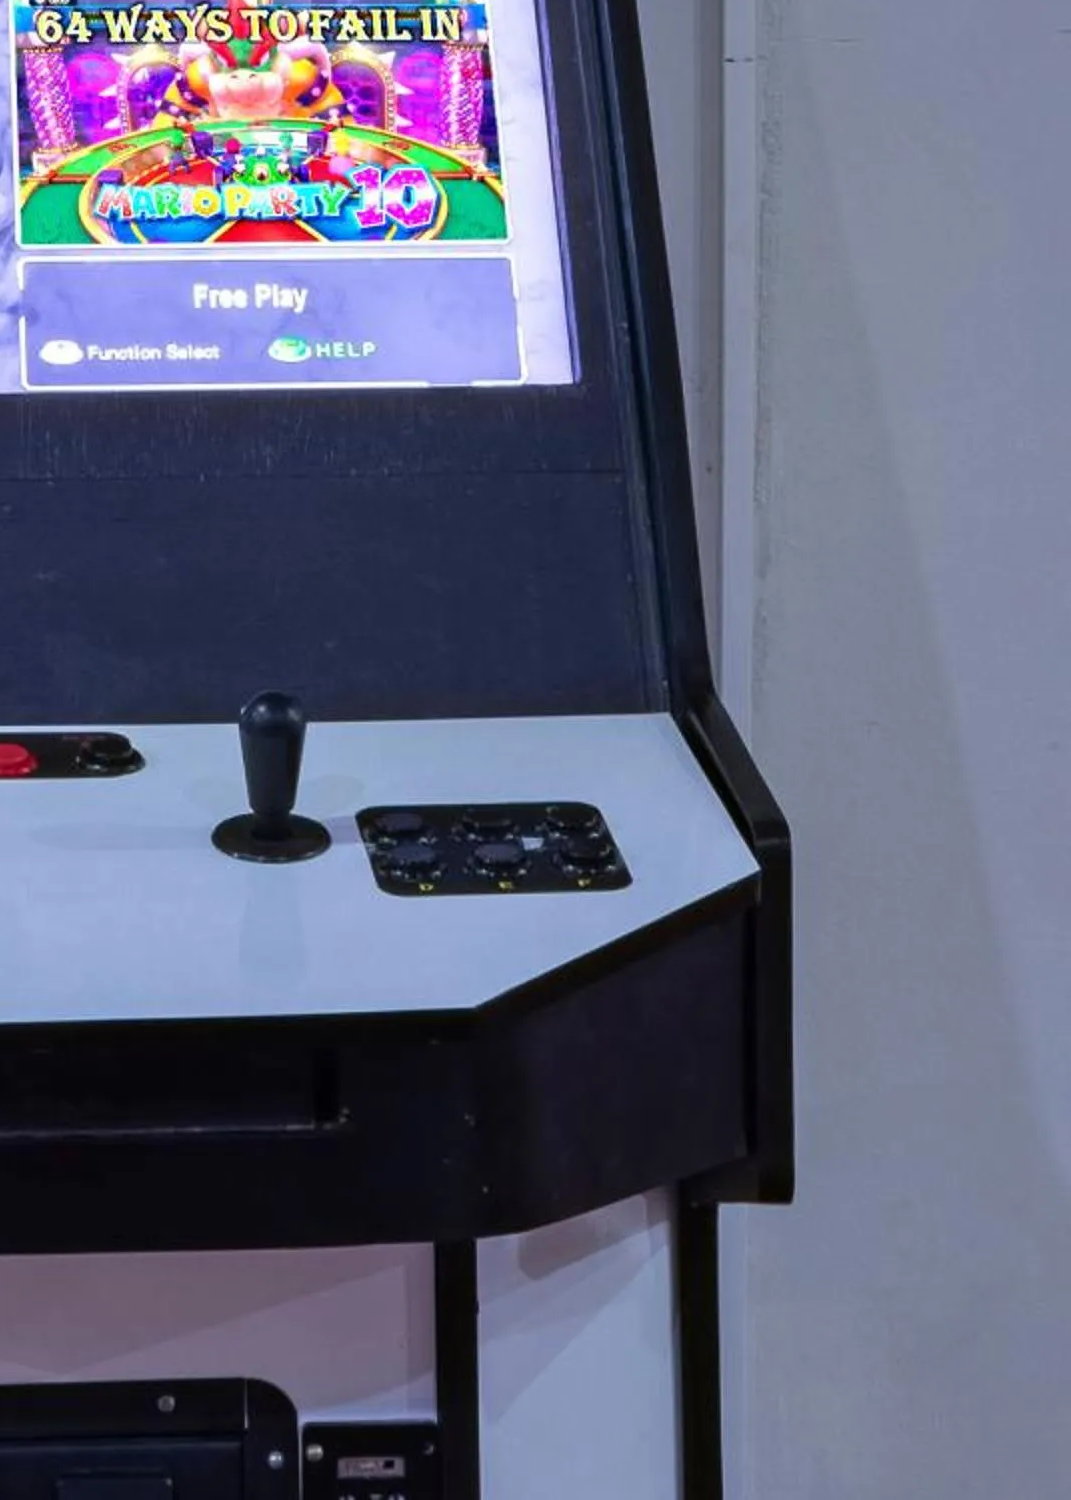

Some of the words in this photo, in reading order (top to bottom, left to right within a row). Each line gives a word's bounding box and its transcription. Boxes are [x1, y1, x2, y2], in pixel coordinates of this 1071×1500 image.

[36, 9, 93, 45] 64
[98, 3, 232, 45] WAYS
[245, 7, 306, 43] TO
[310, 7, 414, 42] FAIL
[418, 7, 461, 41] IN
[95, 184, 216, 219] MARIO
[221, 184, 349, 219] PARTY
[351, 164, 439, 229] 10
[193, 285, 248, 308] Free
[254, 284, 309, 313] Play
[87, 344, 163, 361] Function
[165, 343, 220, 361] Select
[316, 342, 376, 358] HELP
